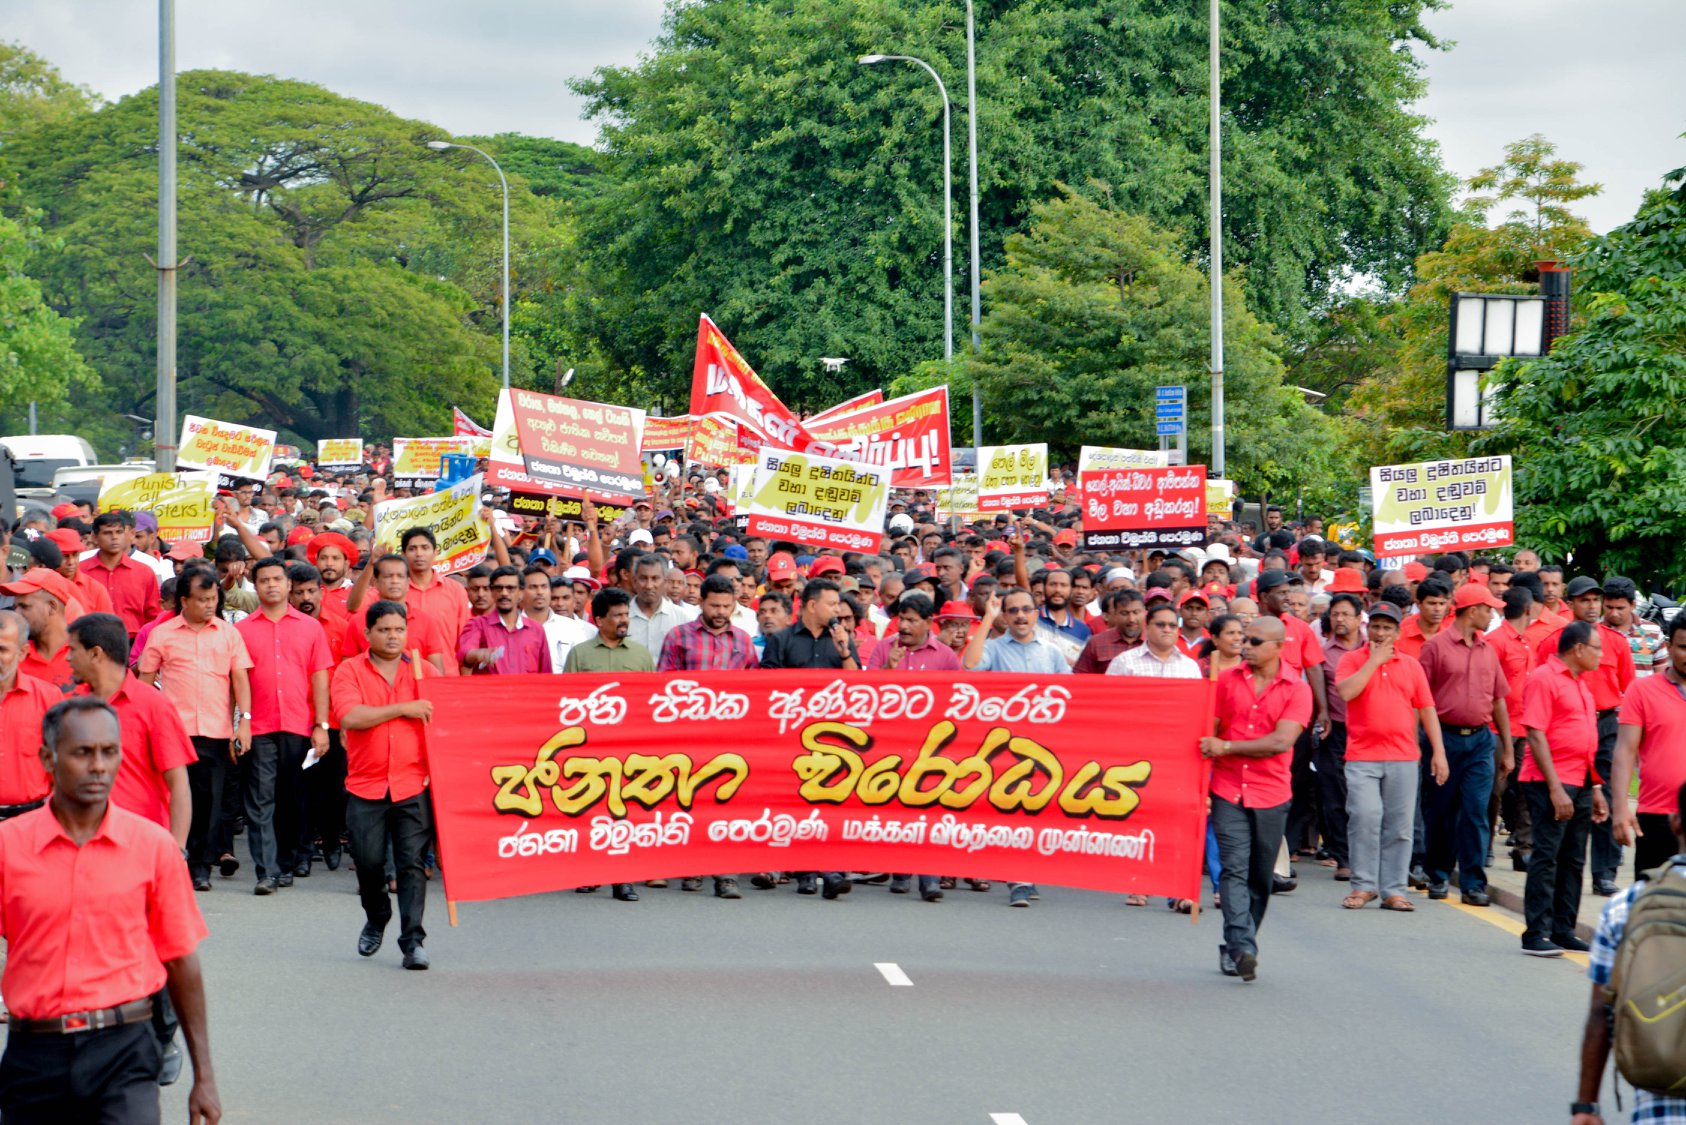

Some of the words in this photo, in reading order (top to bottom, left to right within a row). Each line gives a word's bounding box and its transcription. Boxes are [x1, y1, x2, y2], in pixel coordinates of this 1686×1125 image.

[531, 460, 561, 475] ජනතා
[562, 464, 599, 483] විමුක්ති
[599, 473, 642, 491] පෙරමුණ
[767, 457, 802, 478] සියලු
[1380, 468, 1417, 483] සියලු
[132, 474, 186, 490] Punish
[779, 479, 806, 494] වහා
[138, 491, 159, 502] all
[513, 496, 545, 511] ජනතා
[1397, 488, 1426, 501] වහා
[1089, 498, 1109, 522] මිල
[1113, 499, 1138, 516] වහා
[1410, 503, 1476, 525] ලබාදෙනු!
[184, 526, 209, 539] FRONT
[756, 519, 789, 534] ජනතා
[791, 523, 827, 540] විමුක්ති
[829, 531, 873, 548] පෙරමුණ
[1088, 534, 1120, 545] ජනතා
[1121, 531, 1158, 546] විමුක්ති
[1159, 531, 1204, 545] පෙරමුණ
[1383, 537, 1418, 550] ජනතා
[1420, 531, 1459, 549] විමුක්ති
[1461, 528, 1509, 543] පෙරමුණ
[559, 681, 627, 726] ජන
[490, 725, 749, 820] ජනතා
[792, 719, 1152, 822] විරෝධය
[498, 821, 578, 858] ජනතා
[589, 812, 694, 855] විමුක්ති
[708, 808, 828, 847] පෙරමුණ
[842, 814, 926, 842] மக்கள்
[929, 814, 1034, 853] விடுதலை
